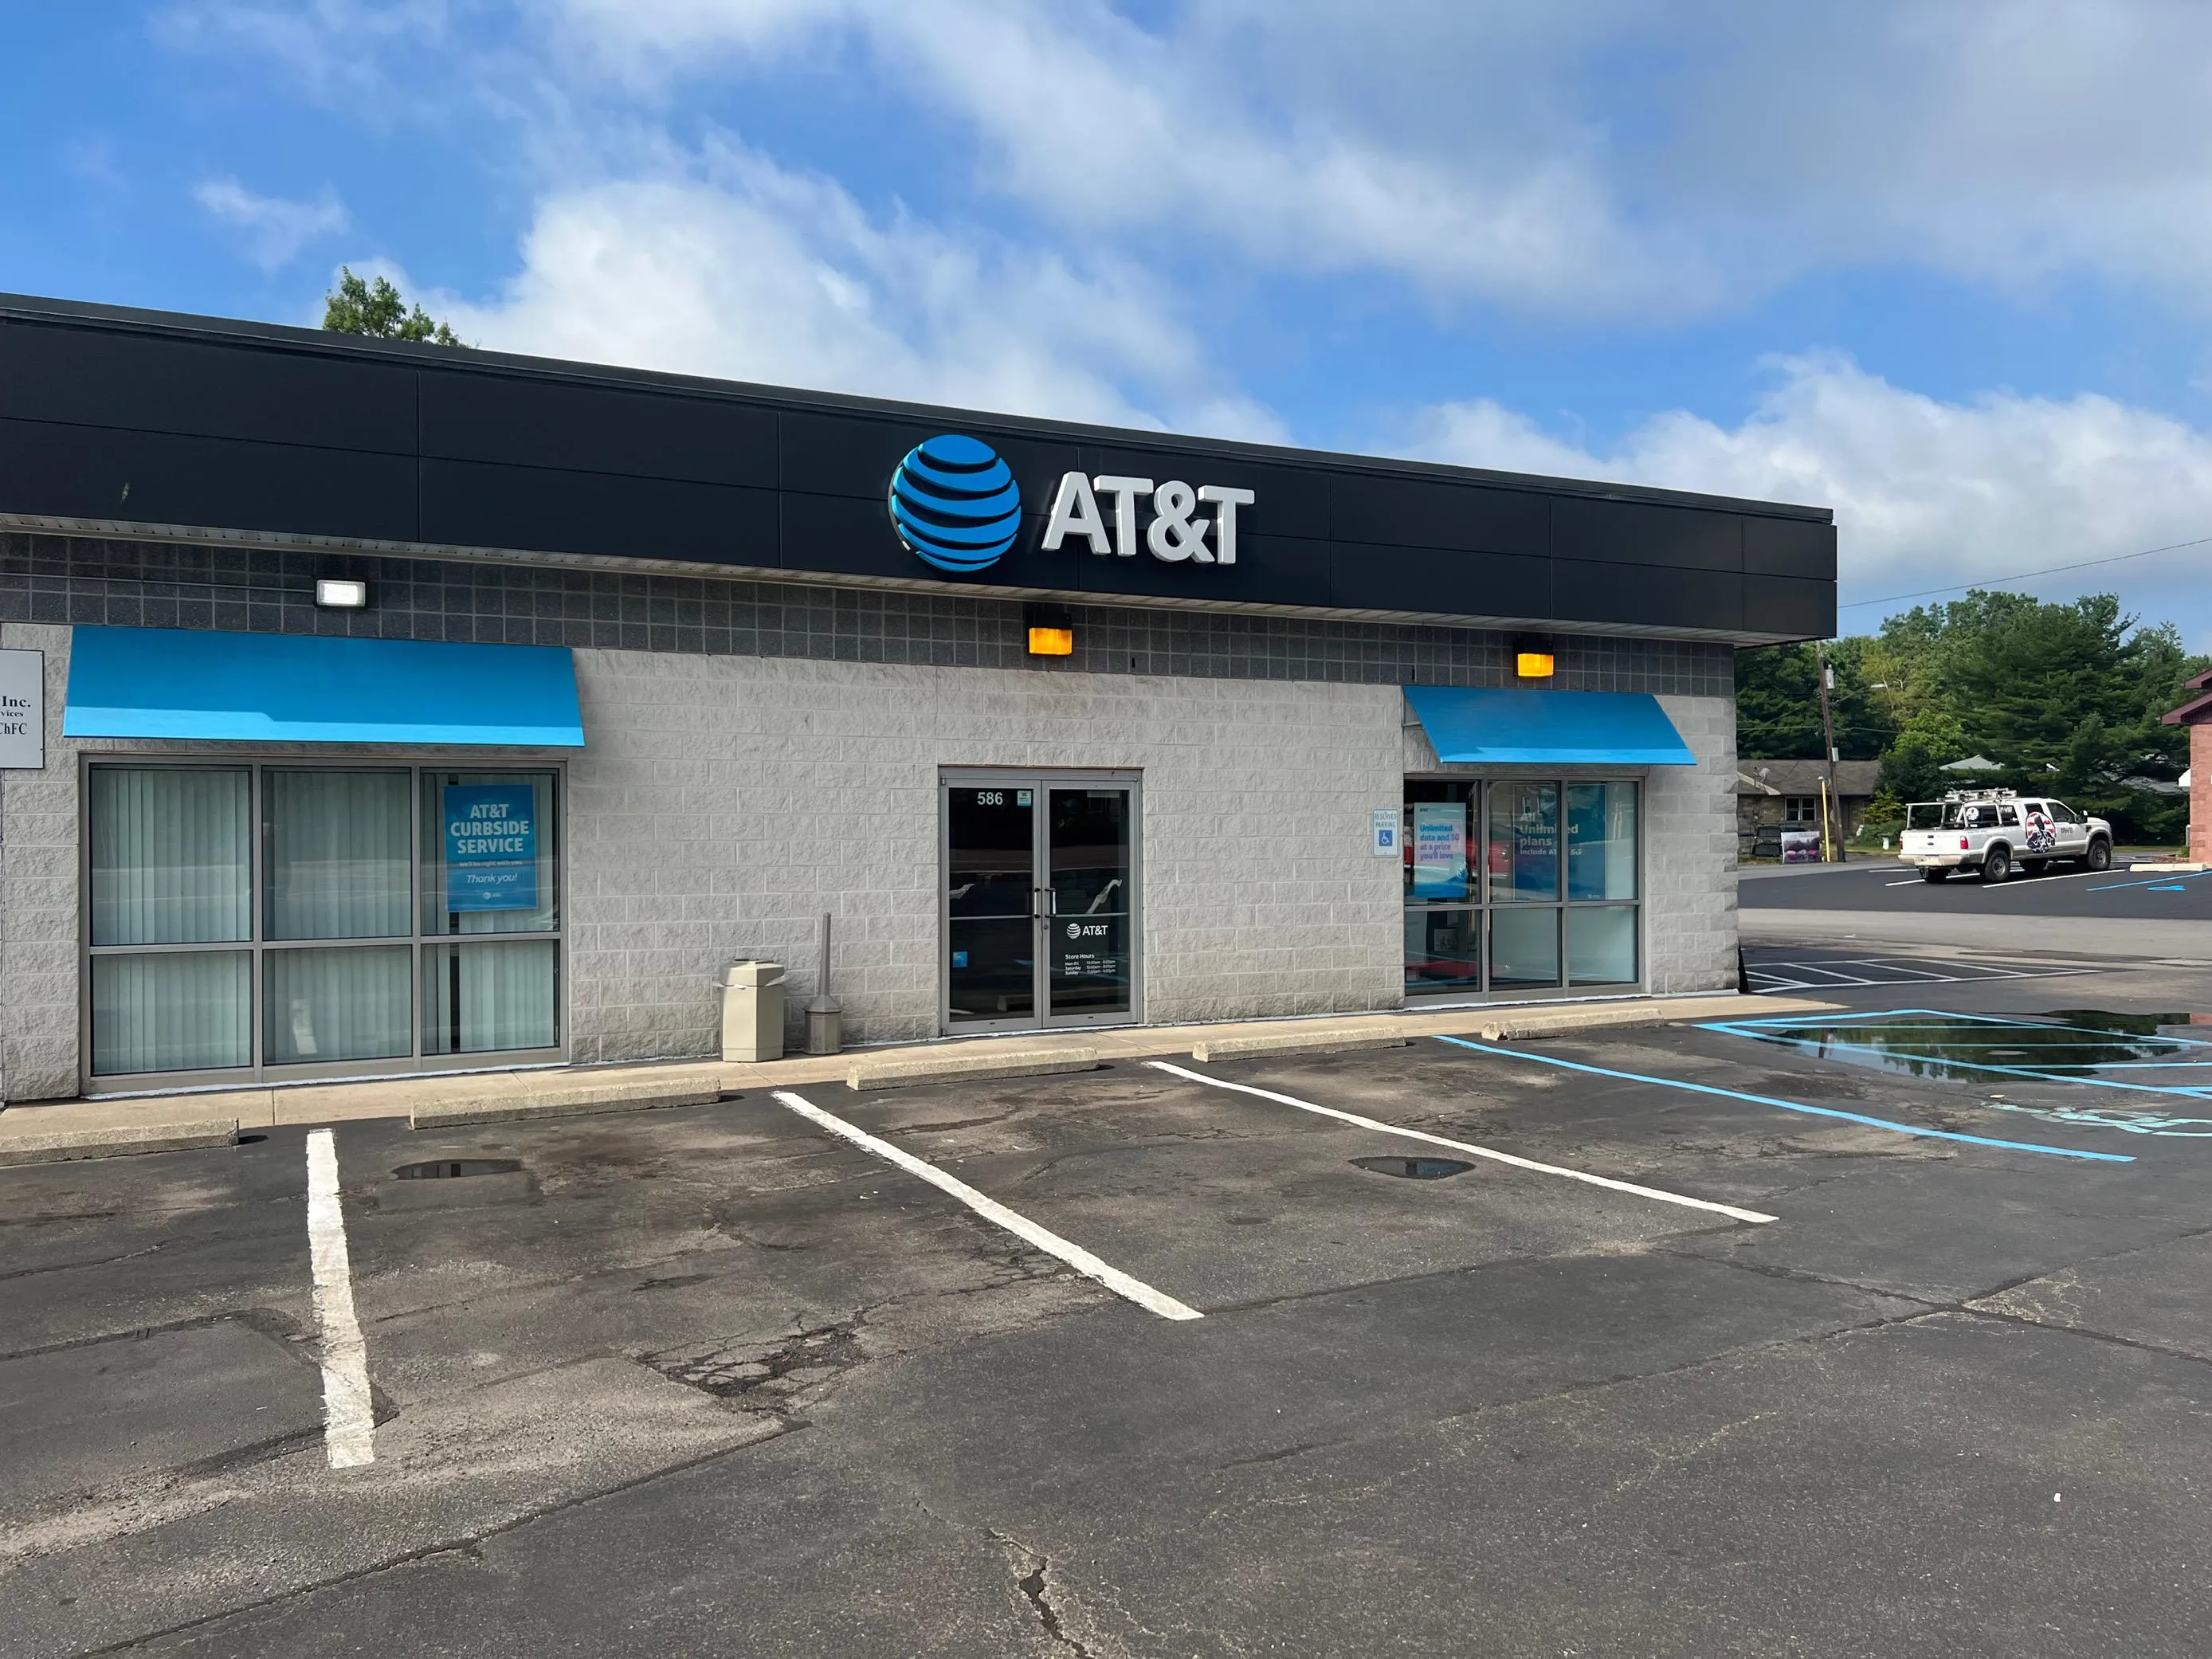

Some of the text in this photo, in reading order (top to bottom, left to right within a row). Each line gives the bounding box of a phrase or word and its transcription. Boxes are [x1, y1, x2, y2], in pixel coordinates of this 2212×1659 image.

[1041, 471, 1255, 565] AT&T
[2, 696, 31, 707] Inc.
[977, 792, 1003, 806] 586
[469, 804, 509, 818] AT&T
[450, 821, 529, 837] CURBSIDE
[457, 838, 524, 854] SERVICE
[1433, 843, 1451, 853] price
[1520, 836, 1552, 849] plans
[1420, 851, 1453, 861] you'll love
[467, 873, 517, 884] Thank you!
[1082, 925, 1108, 935] AT&T
